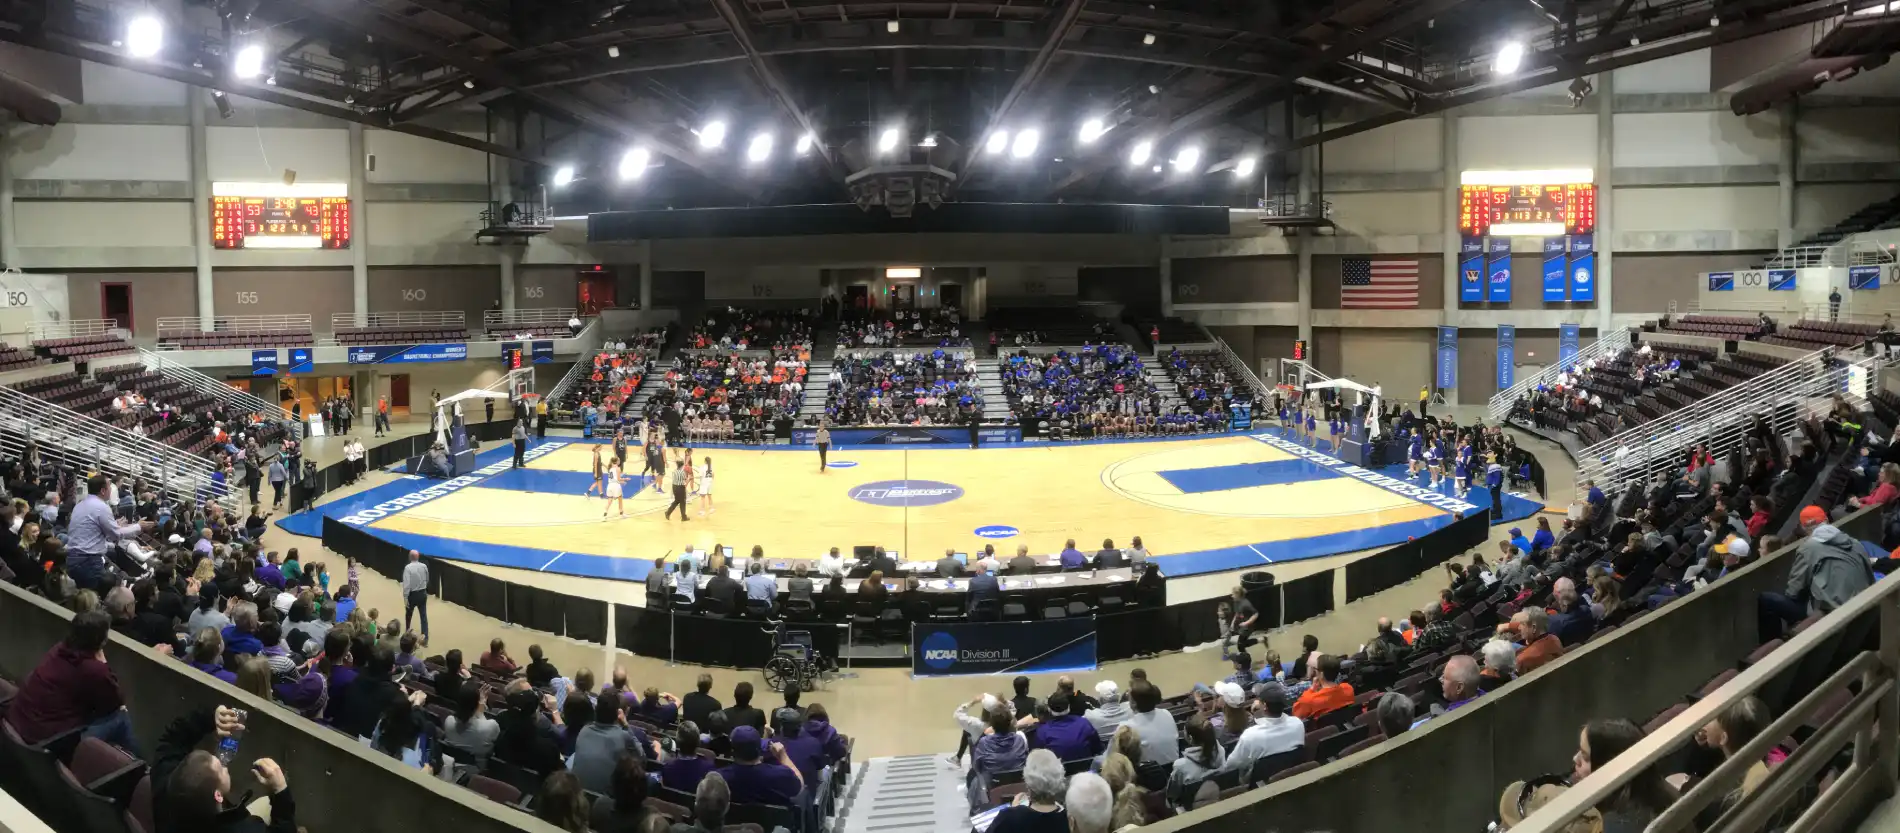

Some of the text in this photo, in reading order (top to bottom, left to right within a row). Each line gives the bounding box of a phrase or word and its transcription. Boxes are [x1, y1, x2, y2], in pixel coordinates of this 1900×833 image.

[1520, 185, 1541, 197] 3:48
[274, 198, 296, 209] 3:48
[1494, 194, 1506, 203] 53
[1550, 193, 1563, 203] 43
[248, 205, 260, 215] 53
[306, 205, 318, 216] 43
[1742, 272, 1762, 285] 100
[401, 289, 426, 301] 160
[525, 286, 544, 299] 165
[1179, 285, 1199, 296] 190
[7, 291, 28, 306] 150
[236, 291, 259, 304] 155
[1250, 433, 1479, 513] ROCHESTER MINNESOTA
[337, 476, 484, 525] ROCHESTER
[925, 649, 1011, 660] NCAA Division III
